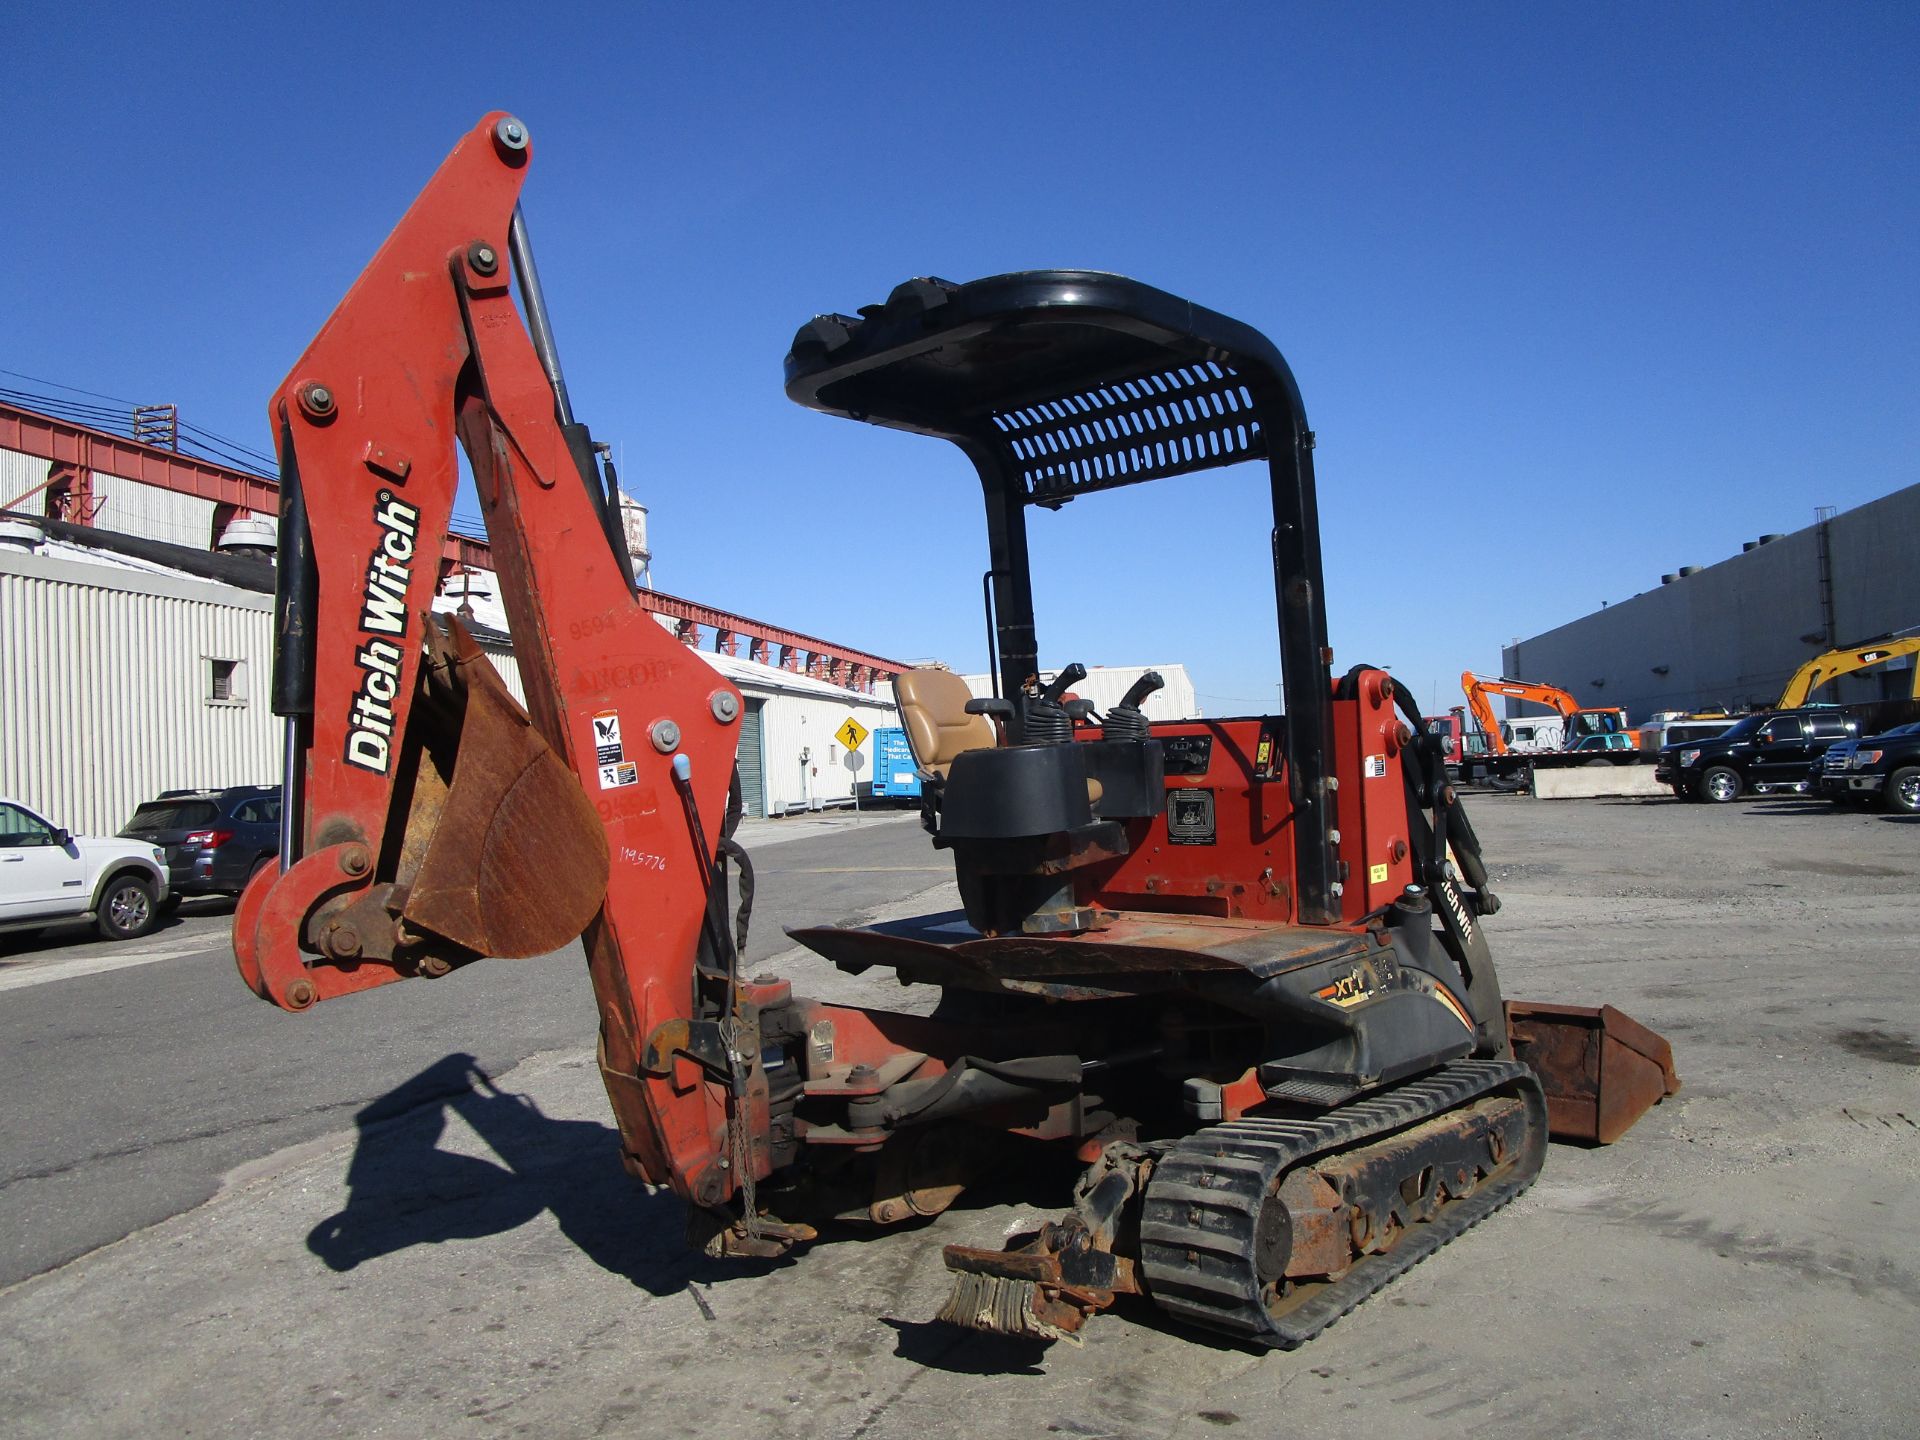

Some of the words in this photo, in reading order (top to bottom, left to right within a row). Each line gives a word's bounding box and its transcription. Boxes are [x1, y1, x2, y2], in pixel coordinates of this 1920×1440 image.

[364, 501, 416, 633] Witch
[348, 641, 400, 773] Ditch
[618, 846, 666, 871] 1195776
